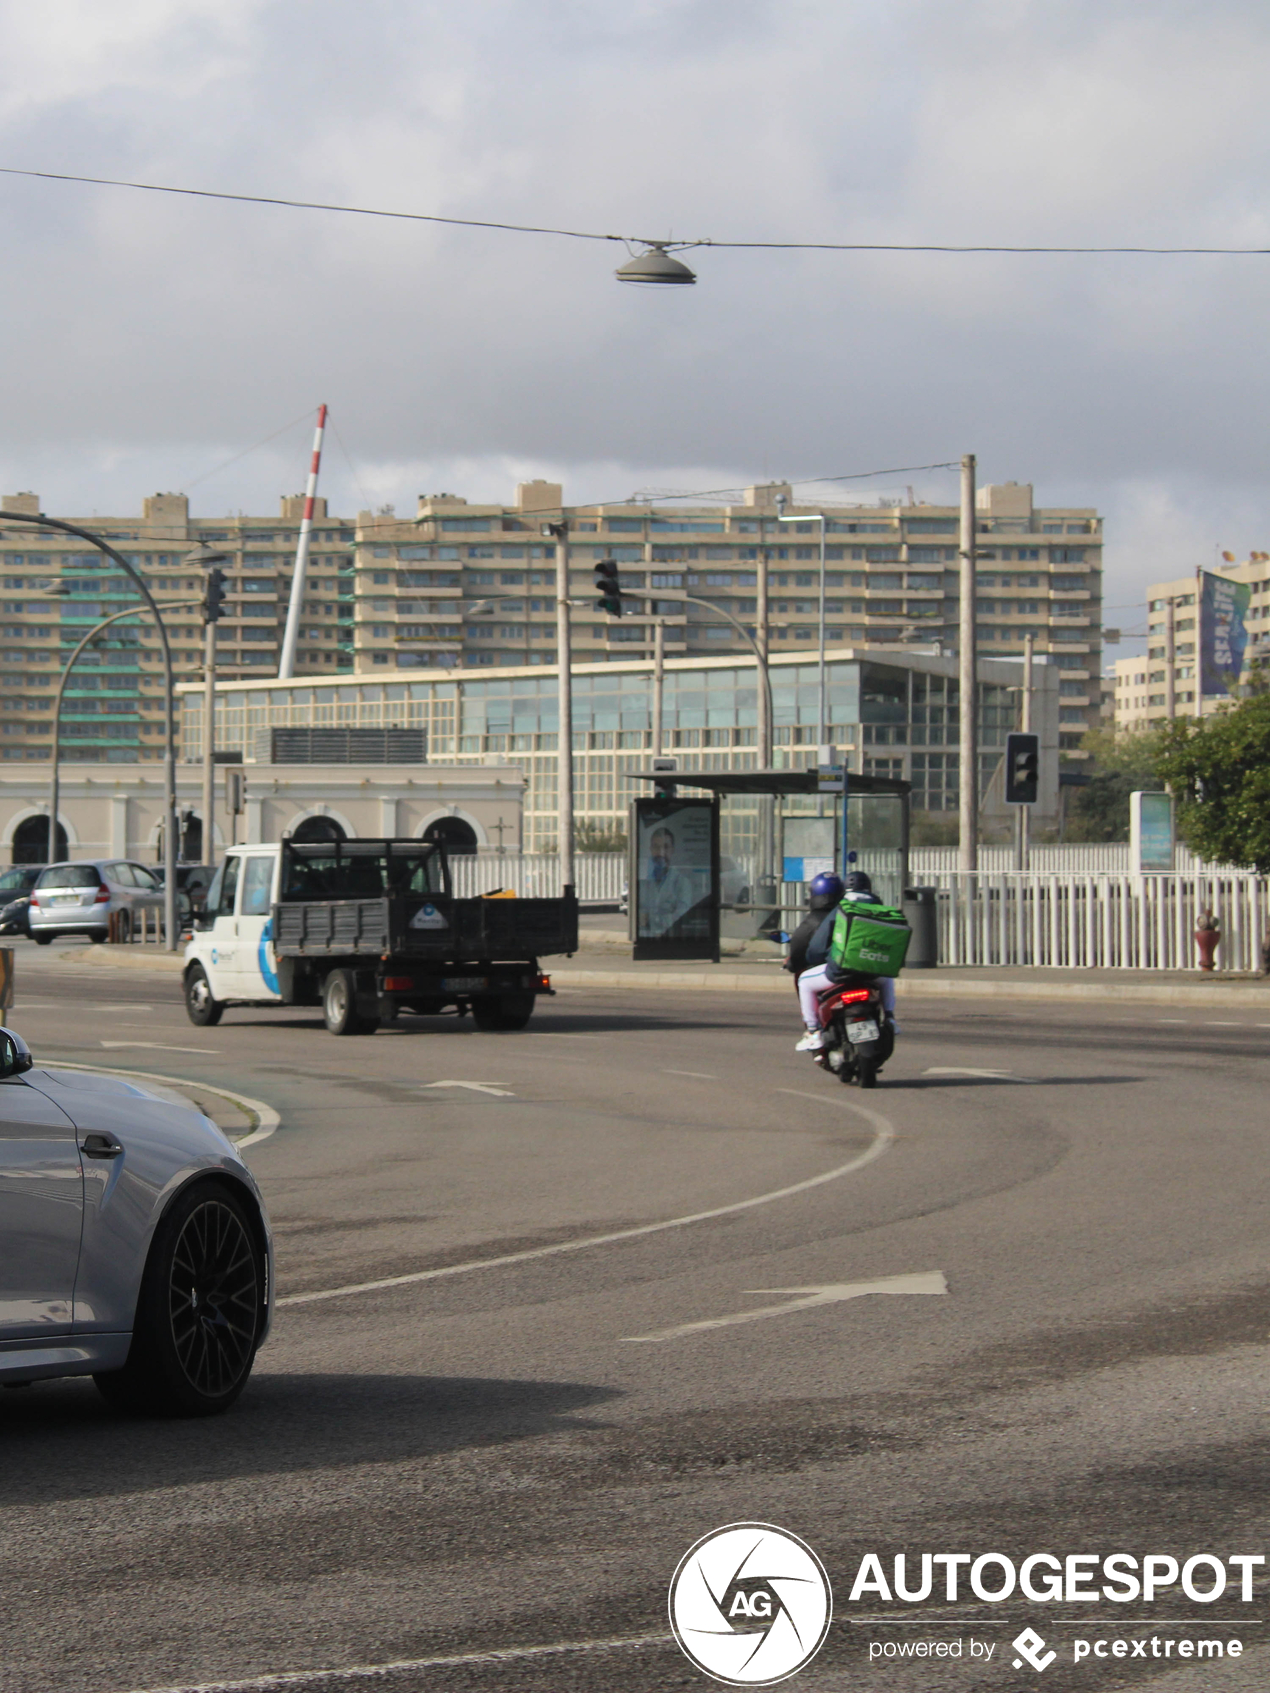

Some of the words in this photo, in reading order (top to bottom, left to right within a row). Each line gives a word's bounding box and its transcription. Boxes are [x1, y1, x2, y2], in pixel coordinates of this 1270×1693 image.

[1214, 626, 1232, 665] SEA
[862, 938, 891, 950] Uber
[859, 948, 889, 962] Eats
